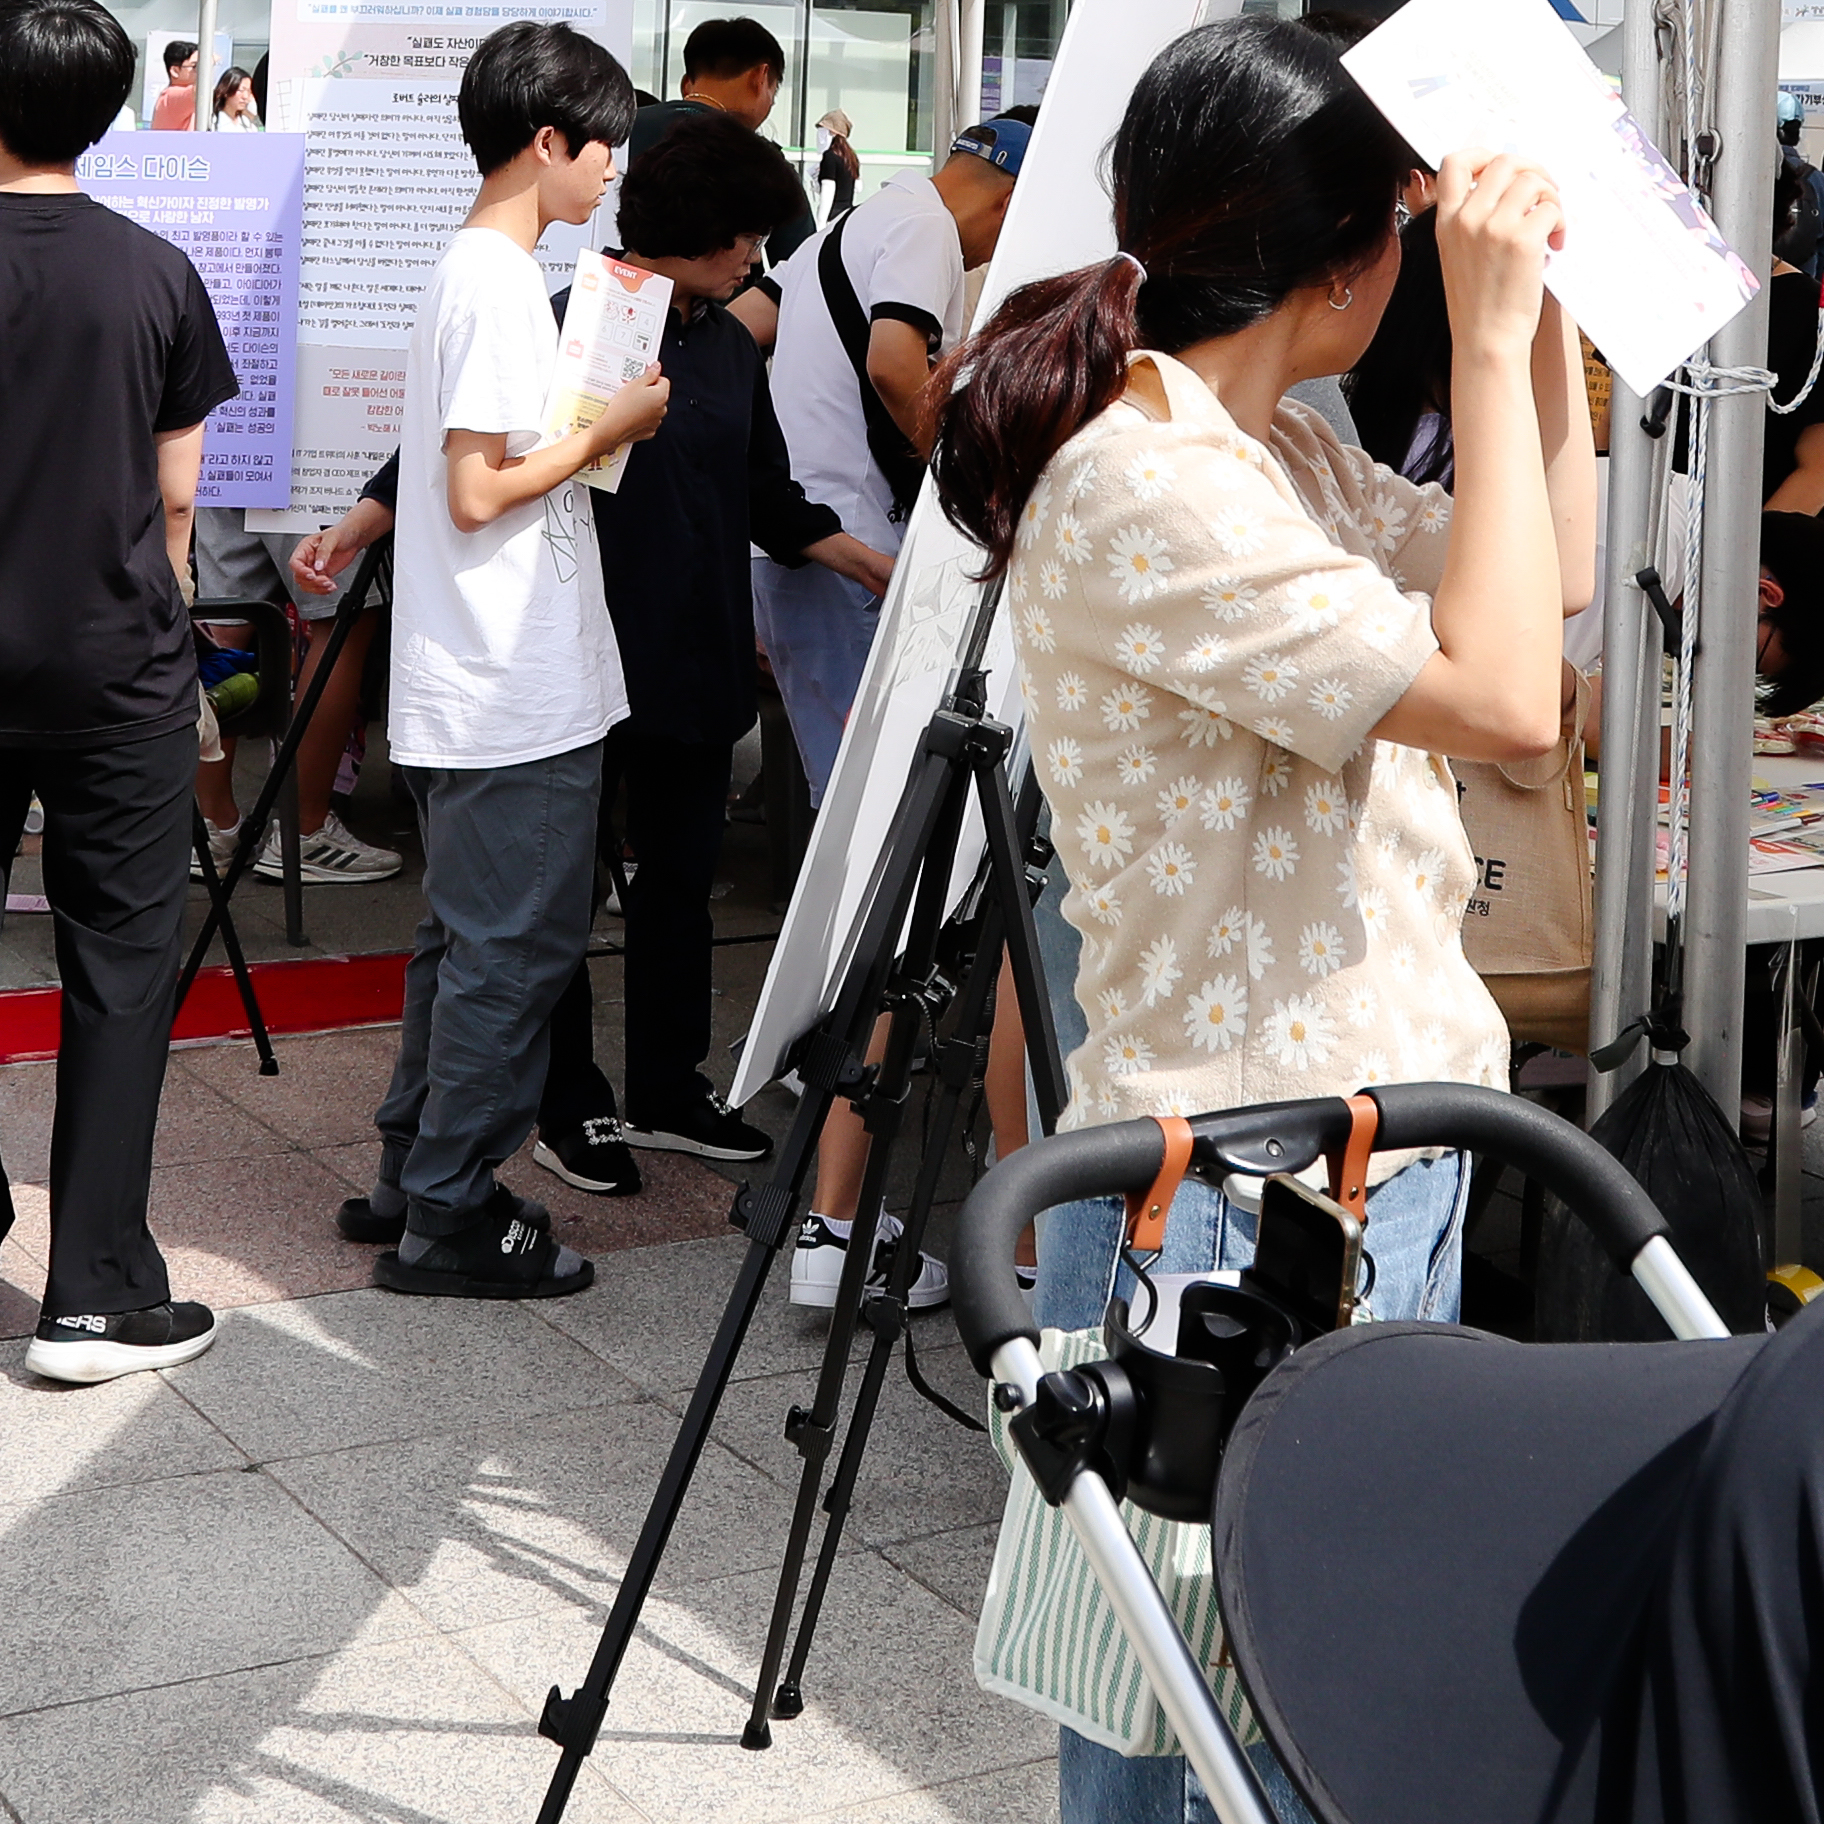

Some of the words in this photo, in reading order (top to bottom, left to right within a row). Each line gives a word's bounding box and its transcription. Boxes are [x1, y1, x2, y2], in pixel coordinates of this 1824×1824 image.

[144, 157, 209, 179] 다이슨
[137, 197, 195, 210] 혁신가이자
[196, 197, 232, 210] 진정한
[233, 197, 269, 211] 발명가
[152, 211, 189, 224] 사랑한
[190, 211, 215, 224] 남자
[237, 279, 281, 290] 아이디어가
